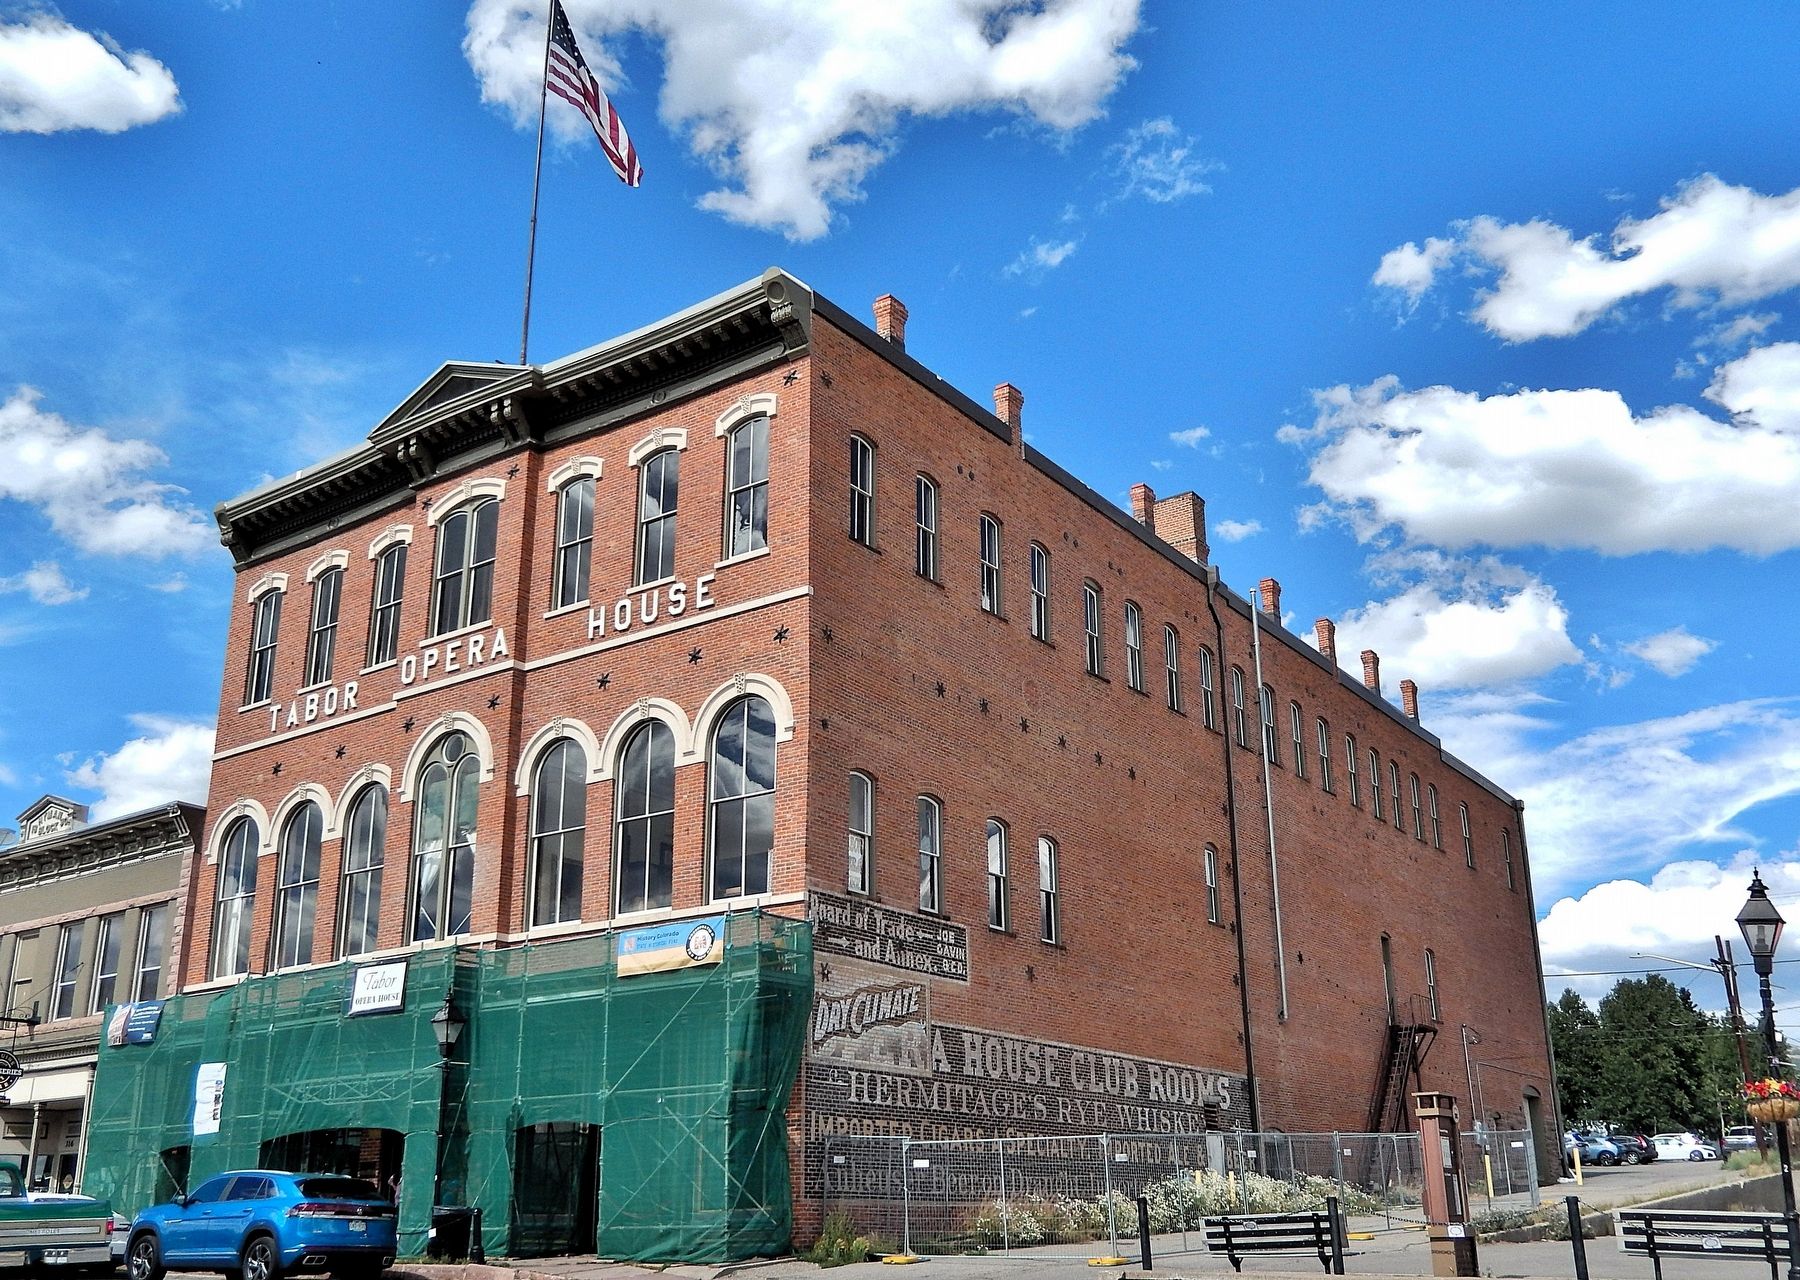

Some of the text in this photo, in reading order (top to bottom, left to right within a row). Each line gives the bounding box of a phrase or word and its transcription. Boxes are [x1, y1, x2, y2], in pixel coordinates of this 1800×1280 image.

[270, 573, 716, 732] TABOR OPERA HOUSE
[809, 893, 915, 941] Board of Trade
[854, 936, 881, 961] and
[936, 928, 955, 944] JOE
[363, 970, 398, 990] Tabor
[378, 992, 400, 1003] HOUSE
[814, 985, 922, 1041] DRY CLIMATE
[962, 1031, 1061, 1087] HOUSE
[1070, 1051, 1140, 1098] CLUB
[1149, 1065, 1231, 1110] ROOMS
[1056, 1096, 1107, 1127] RYE
[920, 1119, 985, 1152] CIGARS
[1783, 1164, 1789, 1173] 2
